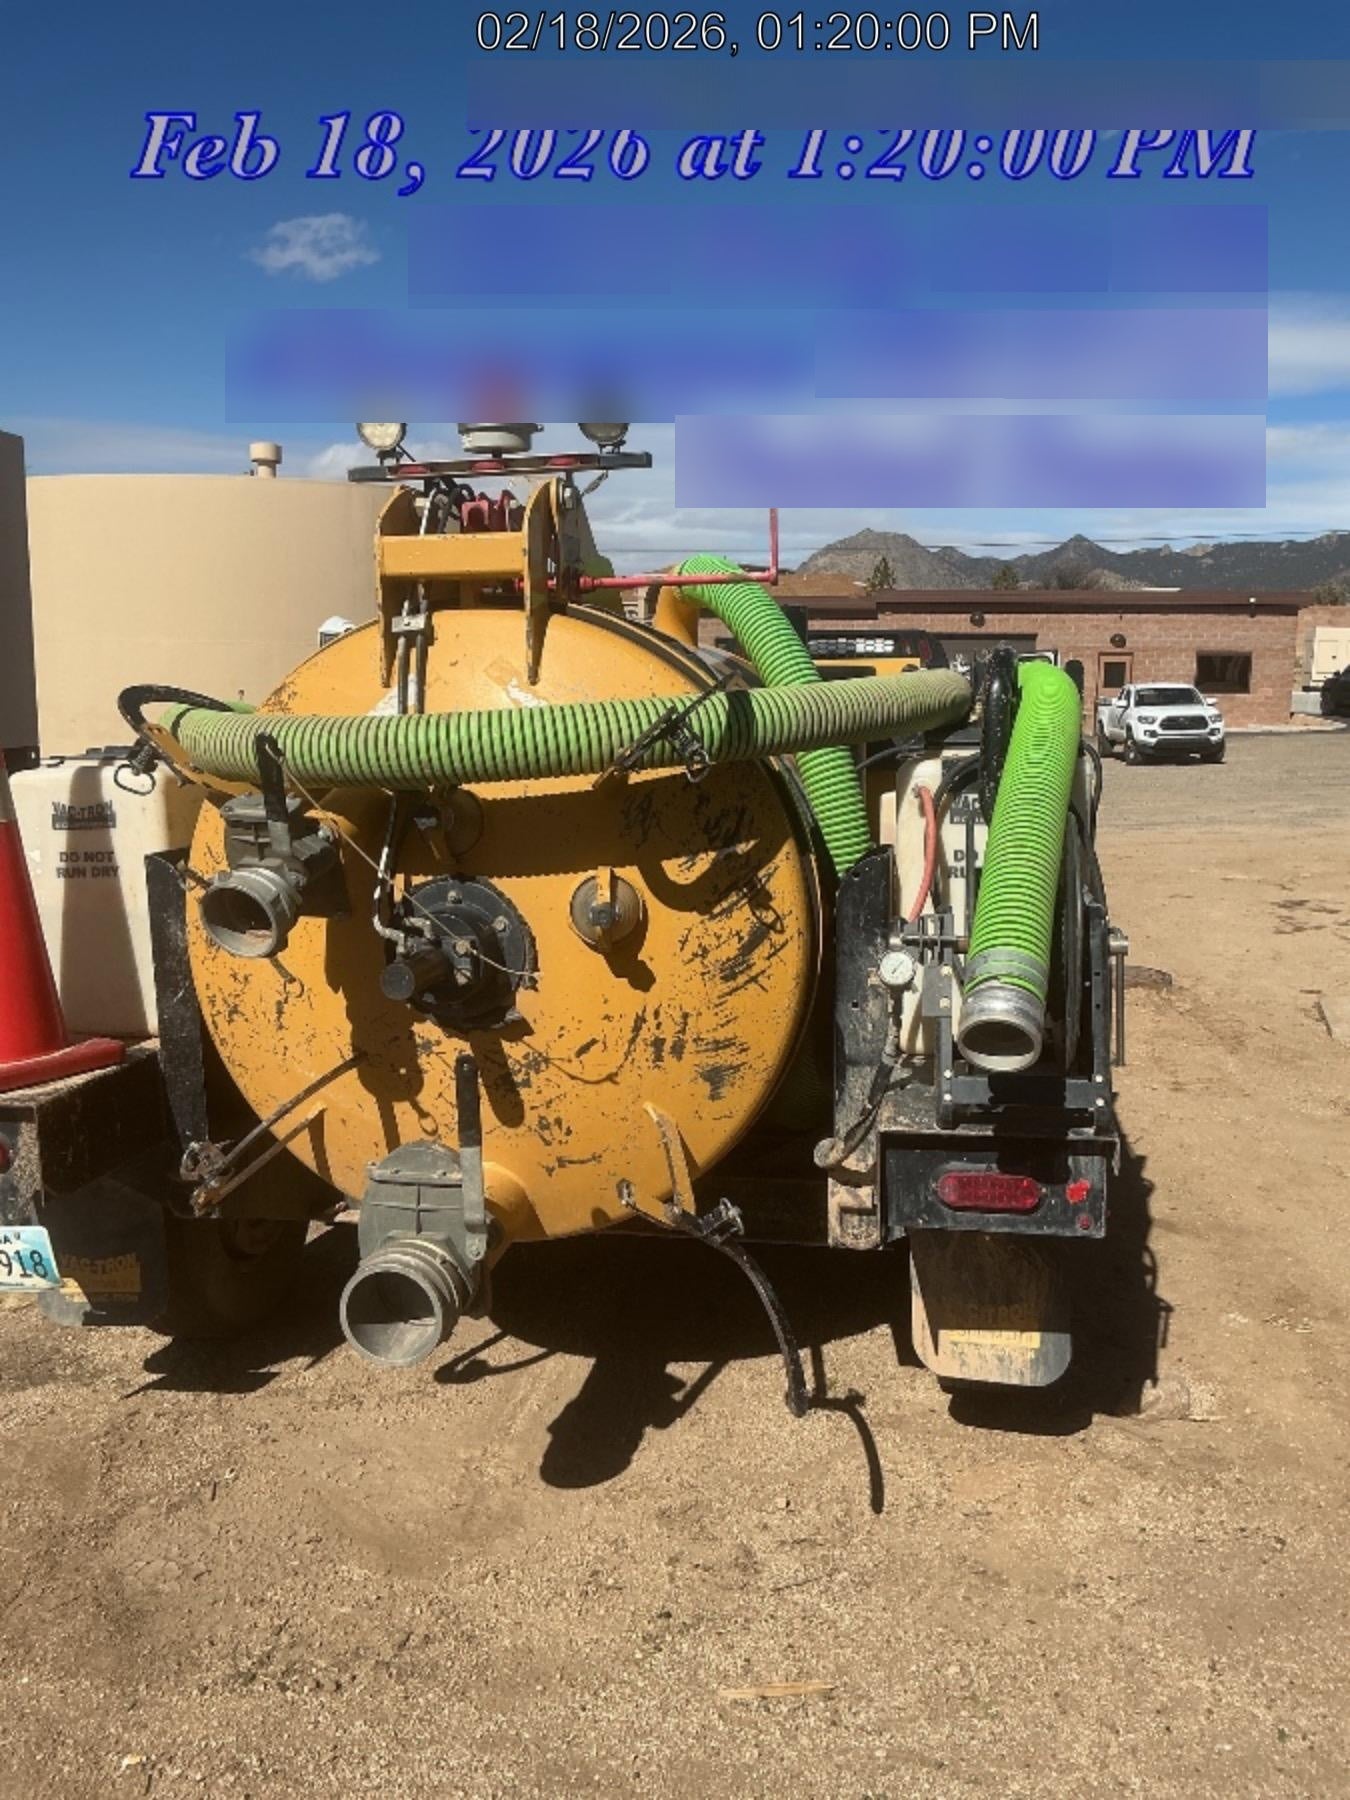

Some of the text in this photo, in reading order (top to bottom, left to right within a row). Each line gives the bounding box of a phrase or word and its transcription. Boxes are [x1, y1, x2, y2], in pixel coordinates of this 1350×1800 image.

[59, 851, 115, 863] DO NOT
[56, 866, 120, 879] RUN DRY
